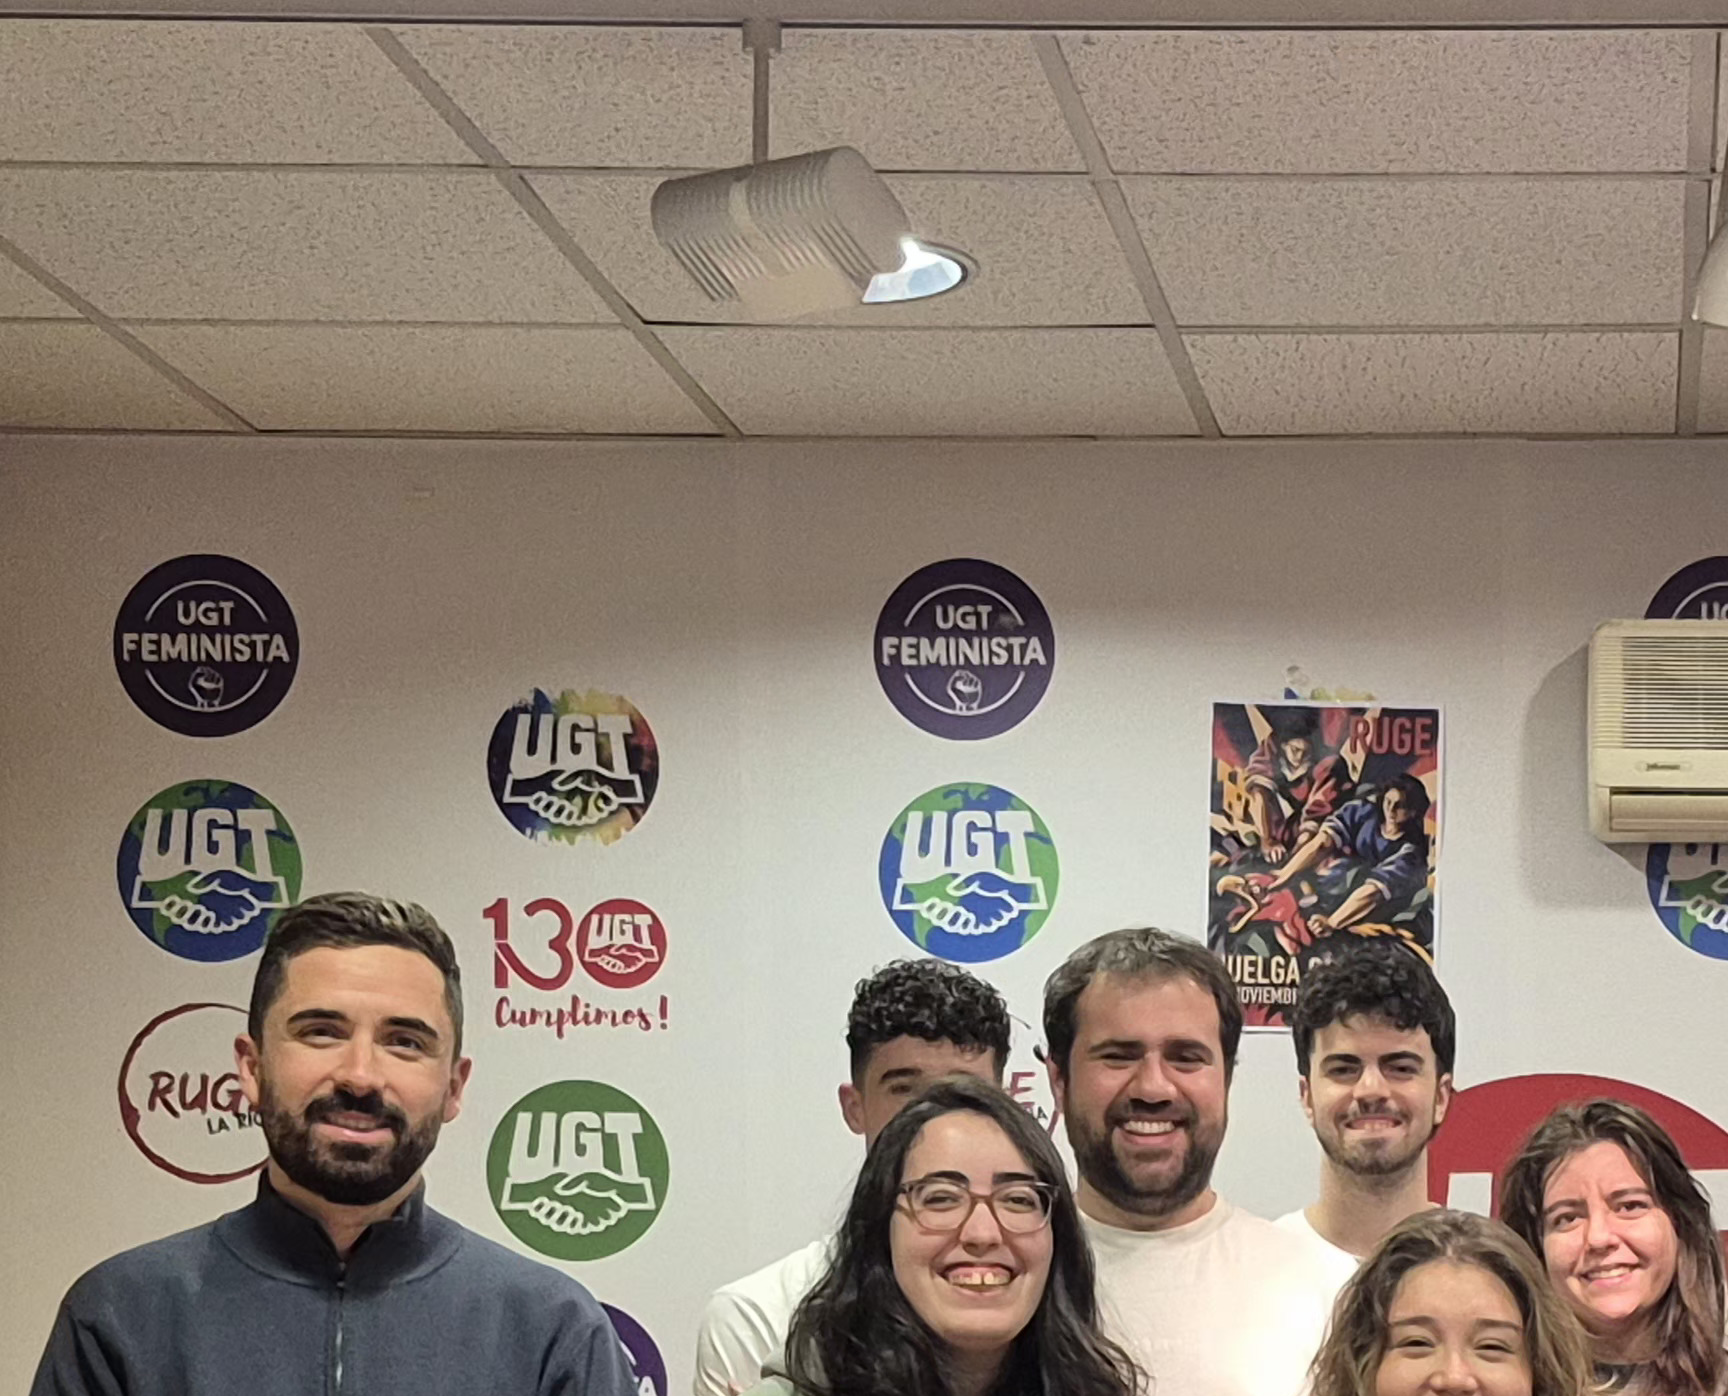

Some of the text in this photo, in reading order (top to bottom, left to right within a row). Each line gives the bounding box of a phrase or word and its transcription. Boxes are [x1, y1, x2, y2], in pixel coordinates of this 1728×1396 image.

[177, 600, 235, 626] UGT
[935, 604, 994, 631] UGT
[122, 632, 290, 664] FEMINISTA
[881, 636, 1046, 667] FEMINISTA
[511, 713, 634, 776] UGT
[1350, 715, 1433, 756] RUGE
[140, 808, 284, 878] UGT
[900, 810, 1037, 881] UGT
[588, 913, 653, 950] UGT
[1222, 953, 1300, 985] UELGA
[1236, 985, 1297, 1005] OVIEMB
[495, 995, 668, 1039] Cumplimos!
[148, 1070, 243, 1119] RUG
[207, 1111, 263, 1135] LA RIO
[508, 1111, 643, 1182] UGT
